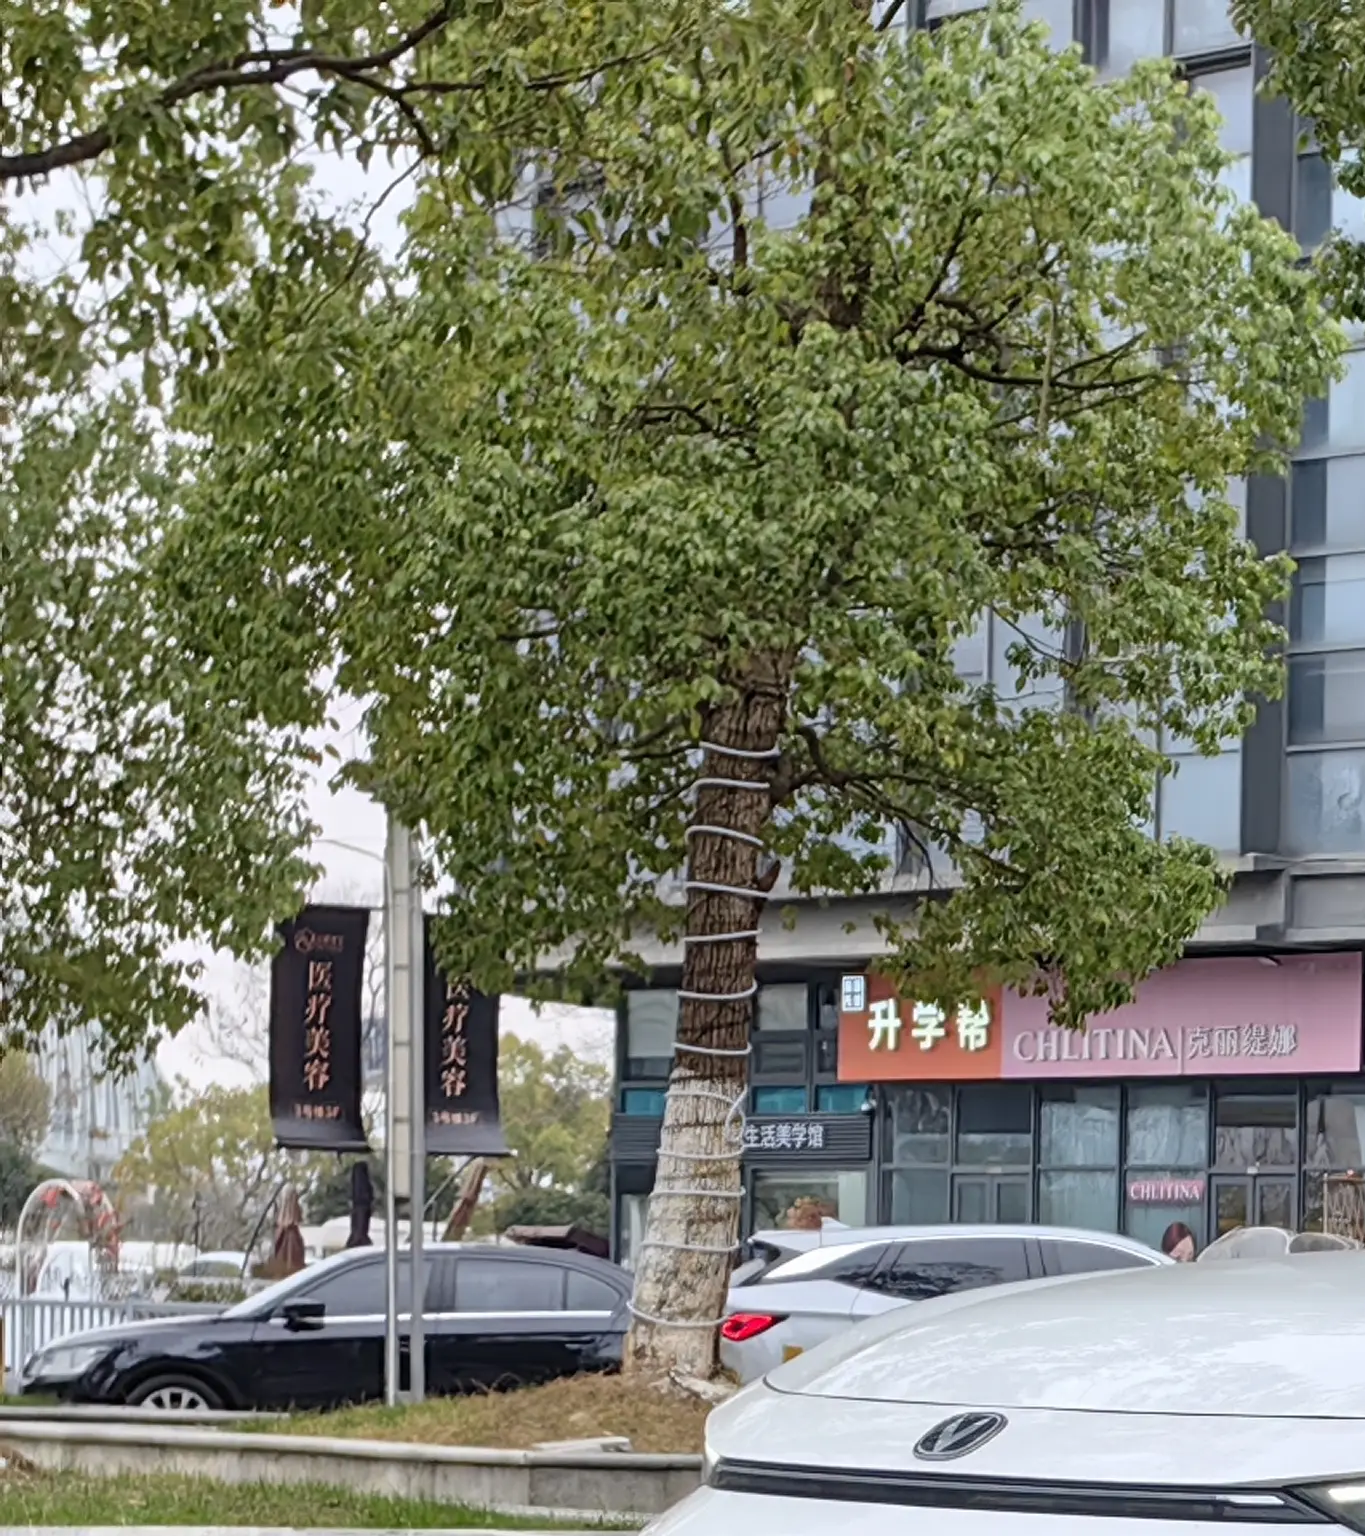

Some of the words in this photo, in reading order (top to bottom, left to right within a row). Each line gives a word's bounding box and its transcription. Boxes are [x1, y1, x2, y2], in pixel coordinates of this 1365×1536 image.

[304, 960, 333, 1091] 医疗美容
[867, 997, 991, 1051] 升学帮
[1187, 1023, 1299, 1060] 克丽缇娜
[1012, 1026, 1176, 1062] CHLITINA
[745, 1122, 824, 1149] 生活美学馆
[1130, 1181, 1200, 1202] CHLITINA
